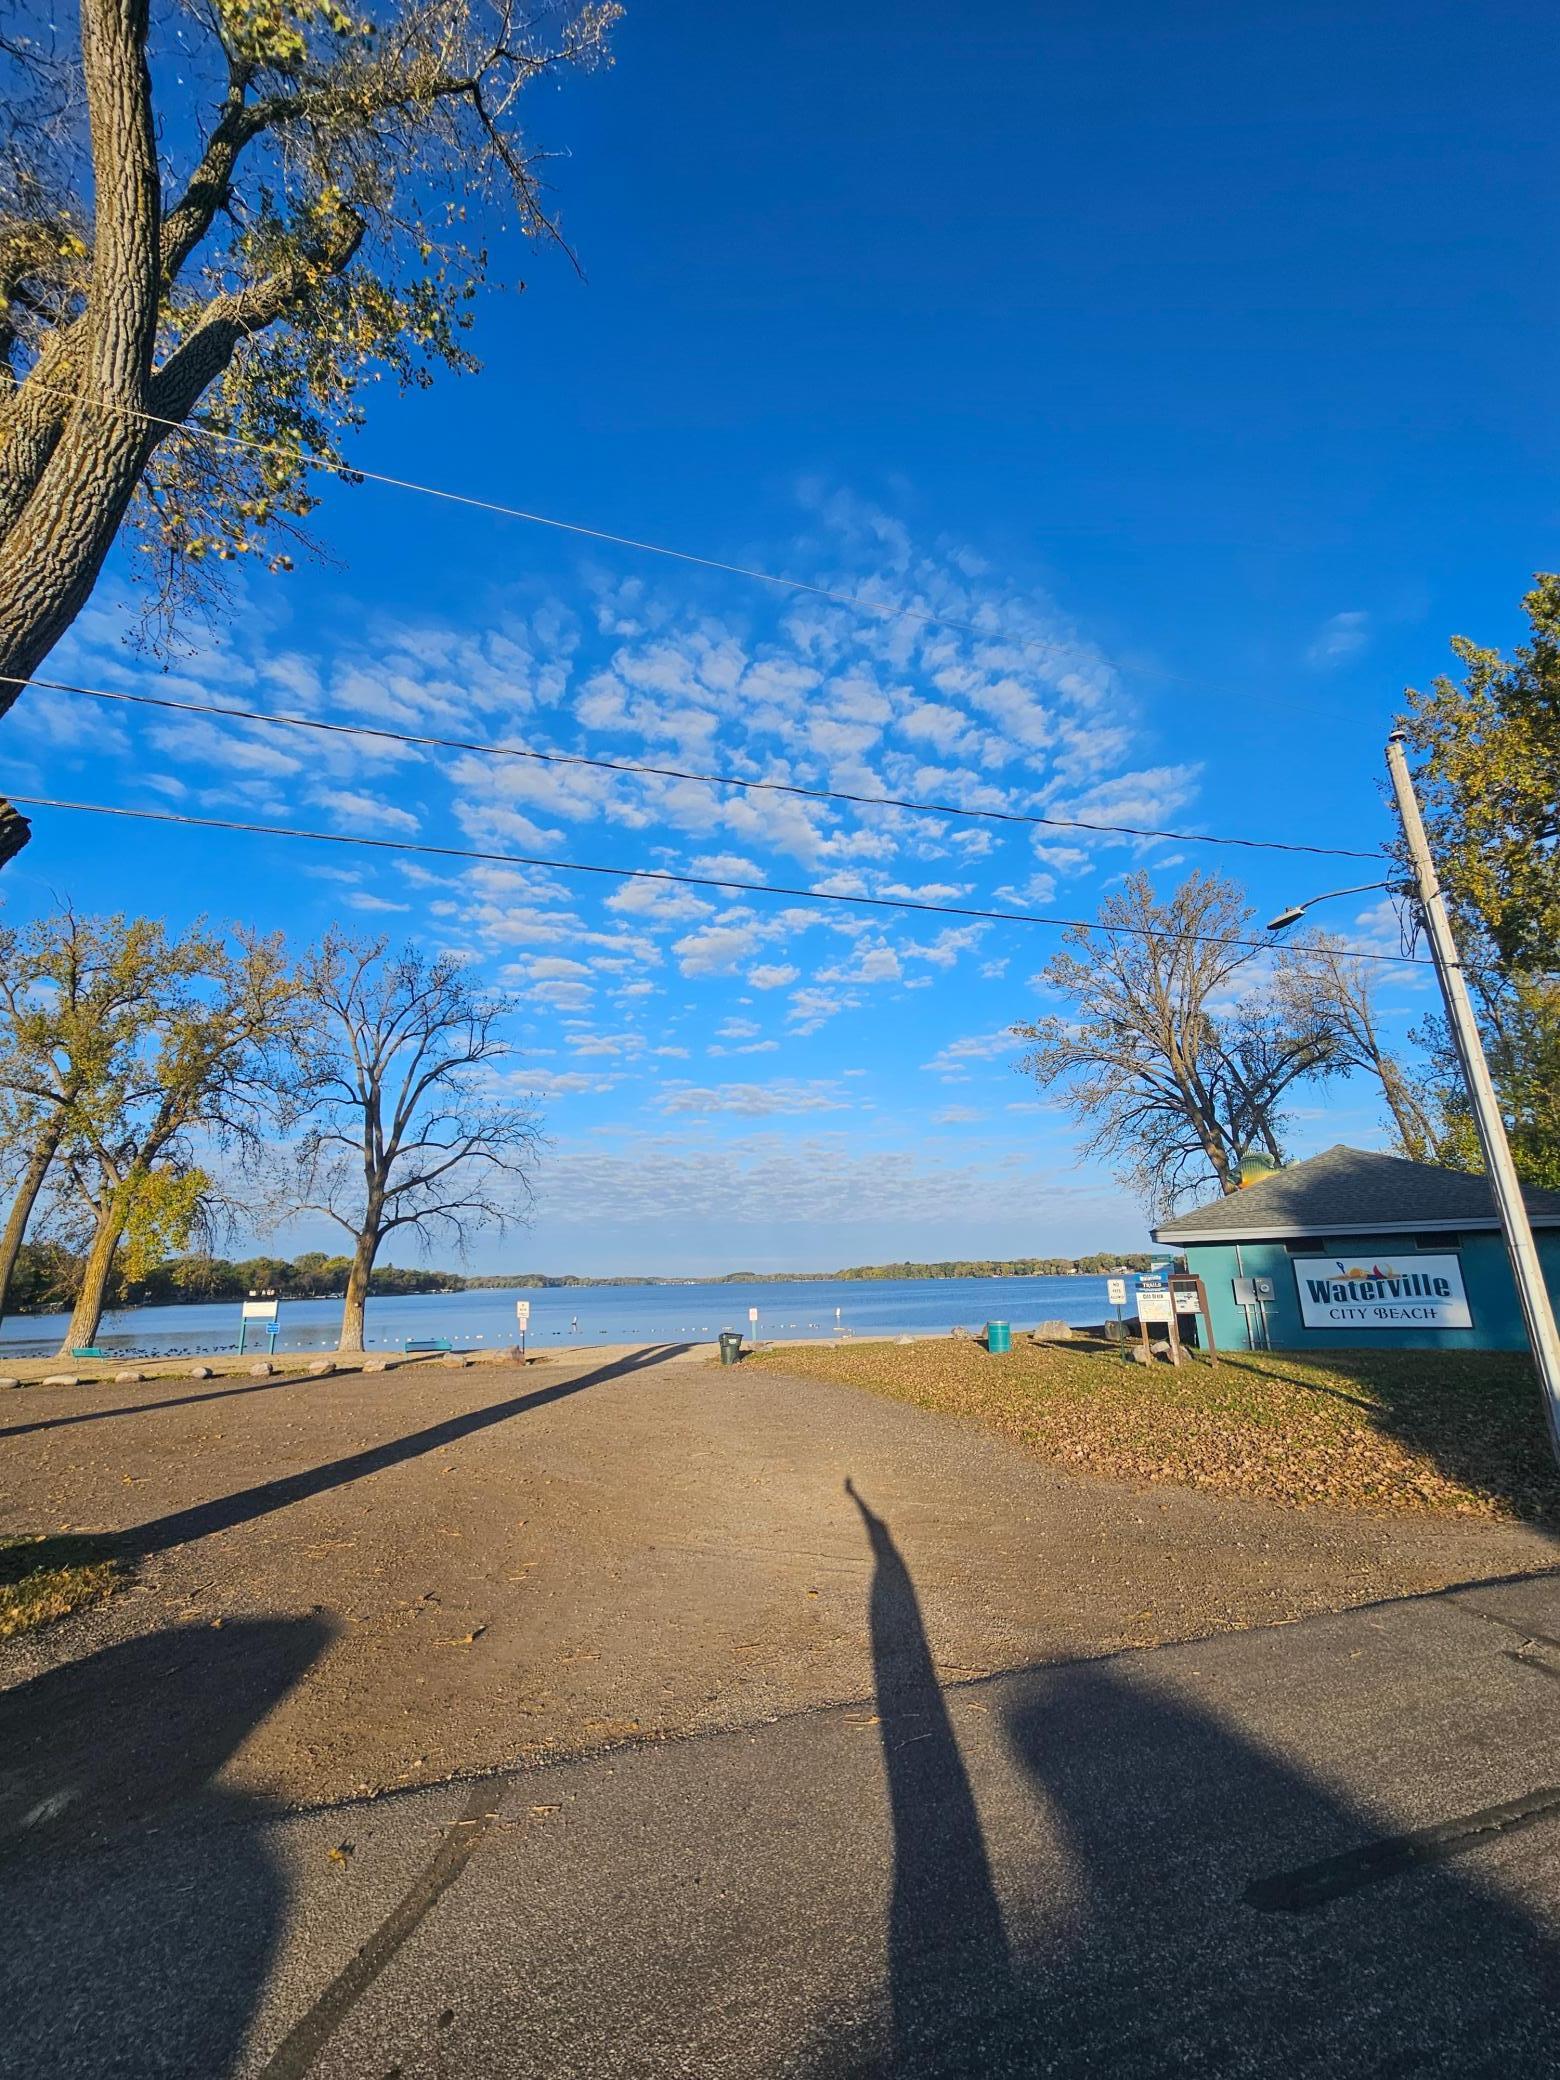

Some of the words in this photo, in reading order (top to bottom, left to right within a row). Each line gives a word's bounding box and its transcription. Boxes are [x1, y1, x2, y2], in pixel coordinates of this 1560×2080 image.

[1306, 1273, 1451, 1304] Waterville
[1329, 1308, 1367, 1320] CITY
[1373, 1307, 1439, 1320] BEACH
